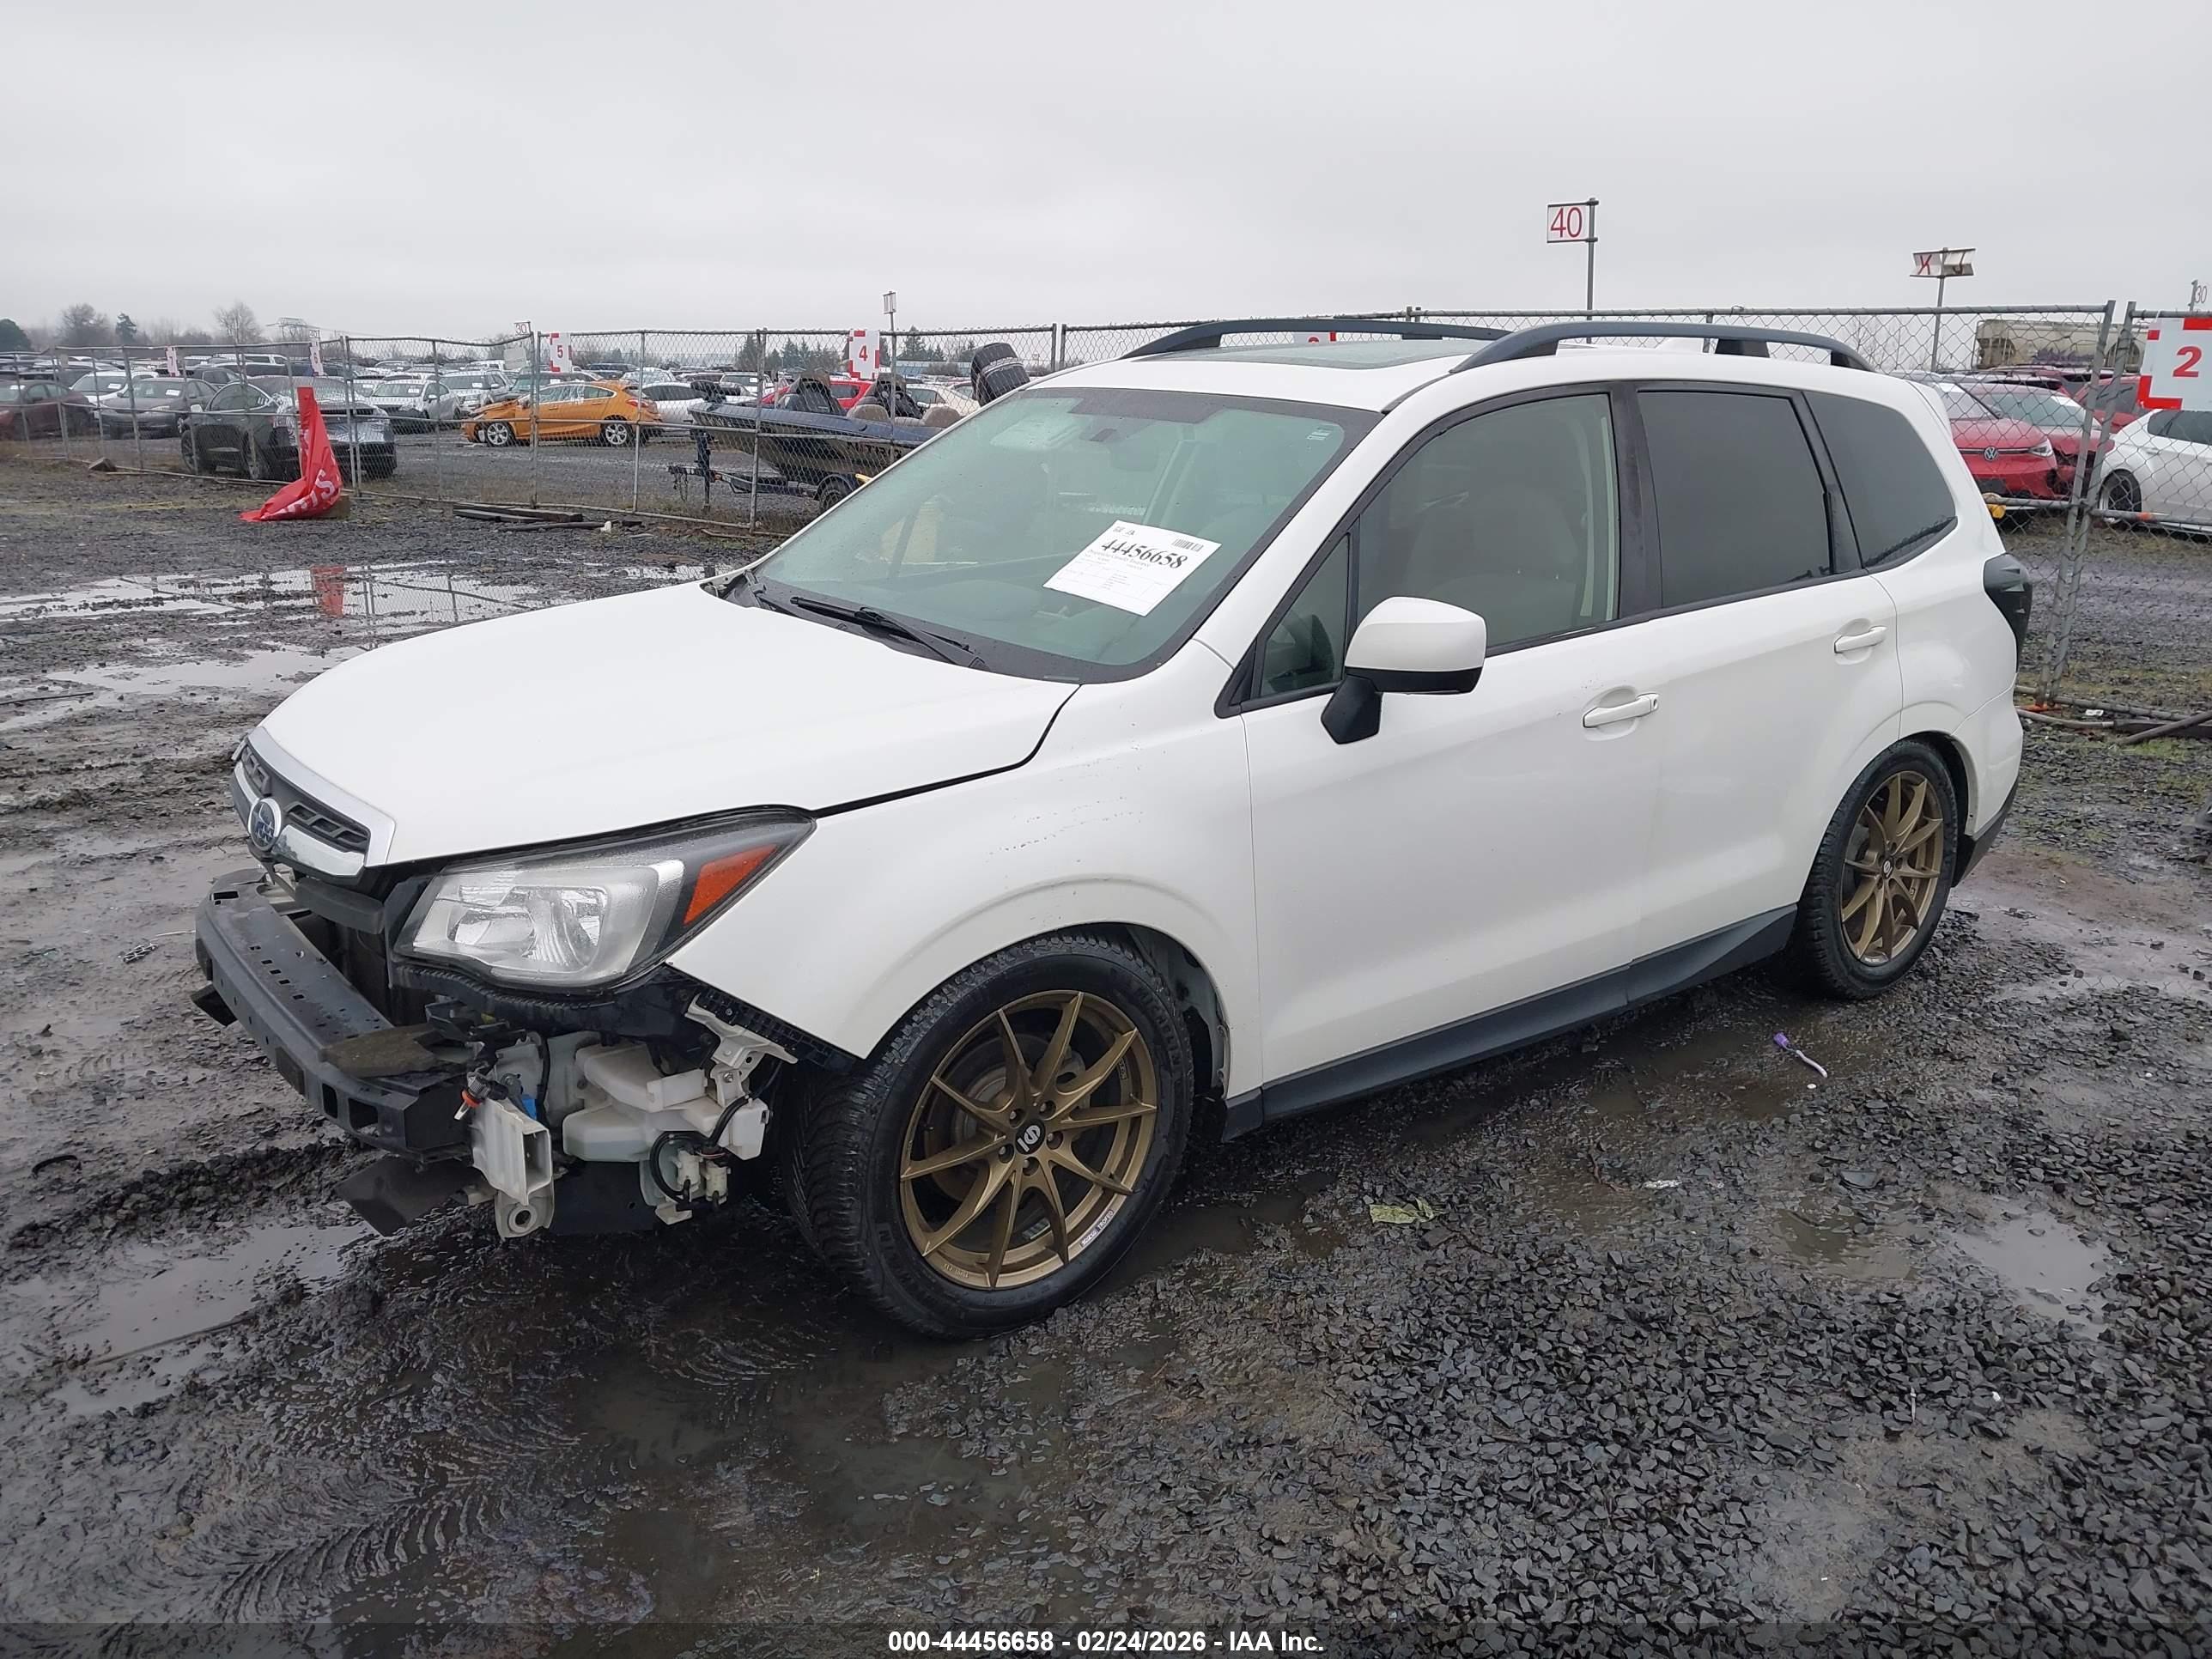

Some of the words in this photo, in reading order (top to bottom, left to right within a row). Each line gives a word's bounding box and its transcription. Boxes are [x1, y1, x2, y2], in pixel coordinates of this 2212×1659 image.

[1550, 207, 1583, 238] 40
[515, 323, 527, 334] 30
[556, 345, 563, 359] 5
[859, 345, 868, 362] 4
[168, 356, 173, 366] 7
[2172, 345, 2203, 378] 2
[1101, 538, 1188, 569] 44456658
